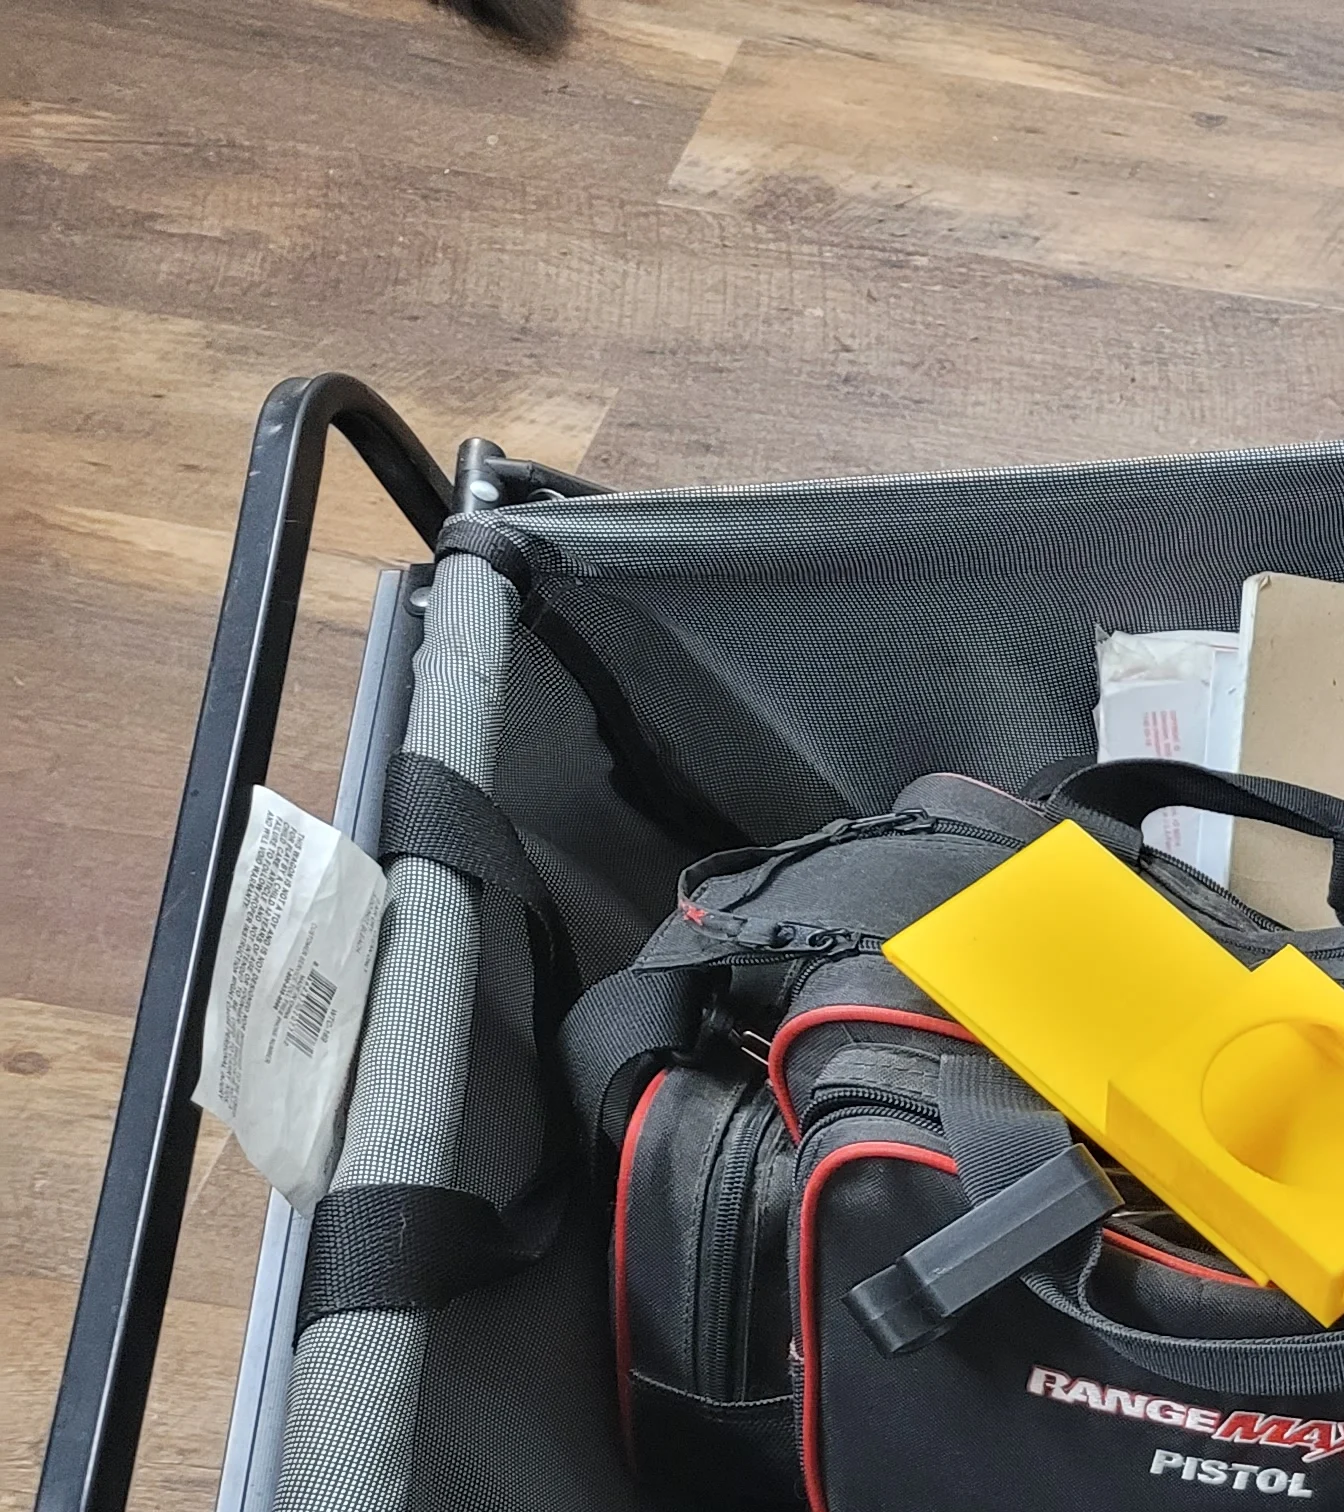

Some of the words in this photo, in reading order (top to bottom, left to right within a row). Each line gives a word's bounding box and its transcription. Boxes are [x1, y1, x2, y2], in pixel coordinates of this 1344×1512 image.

[286, 850, 299, 879] WAGON
[278, 887, 289, 904] NOT
[270, 912, 280, 929] TOY
[262, 928, 273, 946] AND
[254, 956, 264, 973] NOT
[1150, 1449, 1314, 1499] PISTOL
